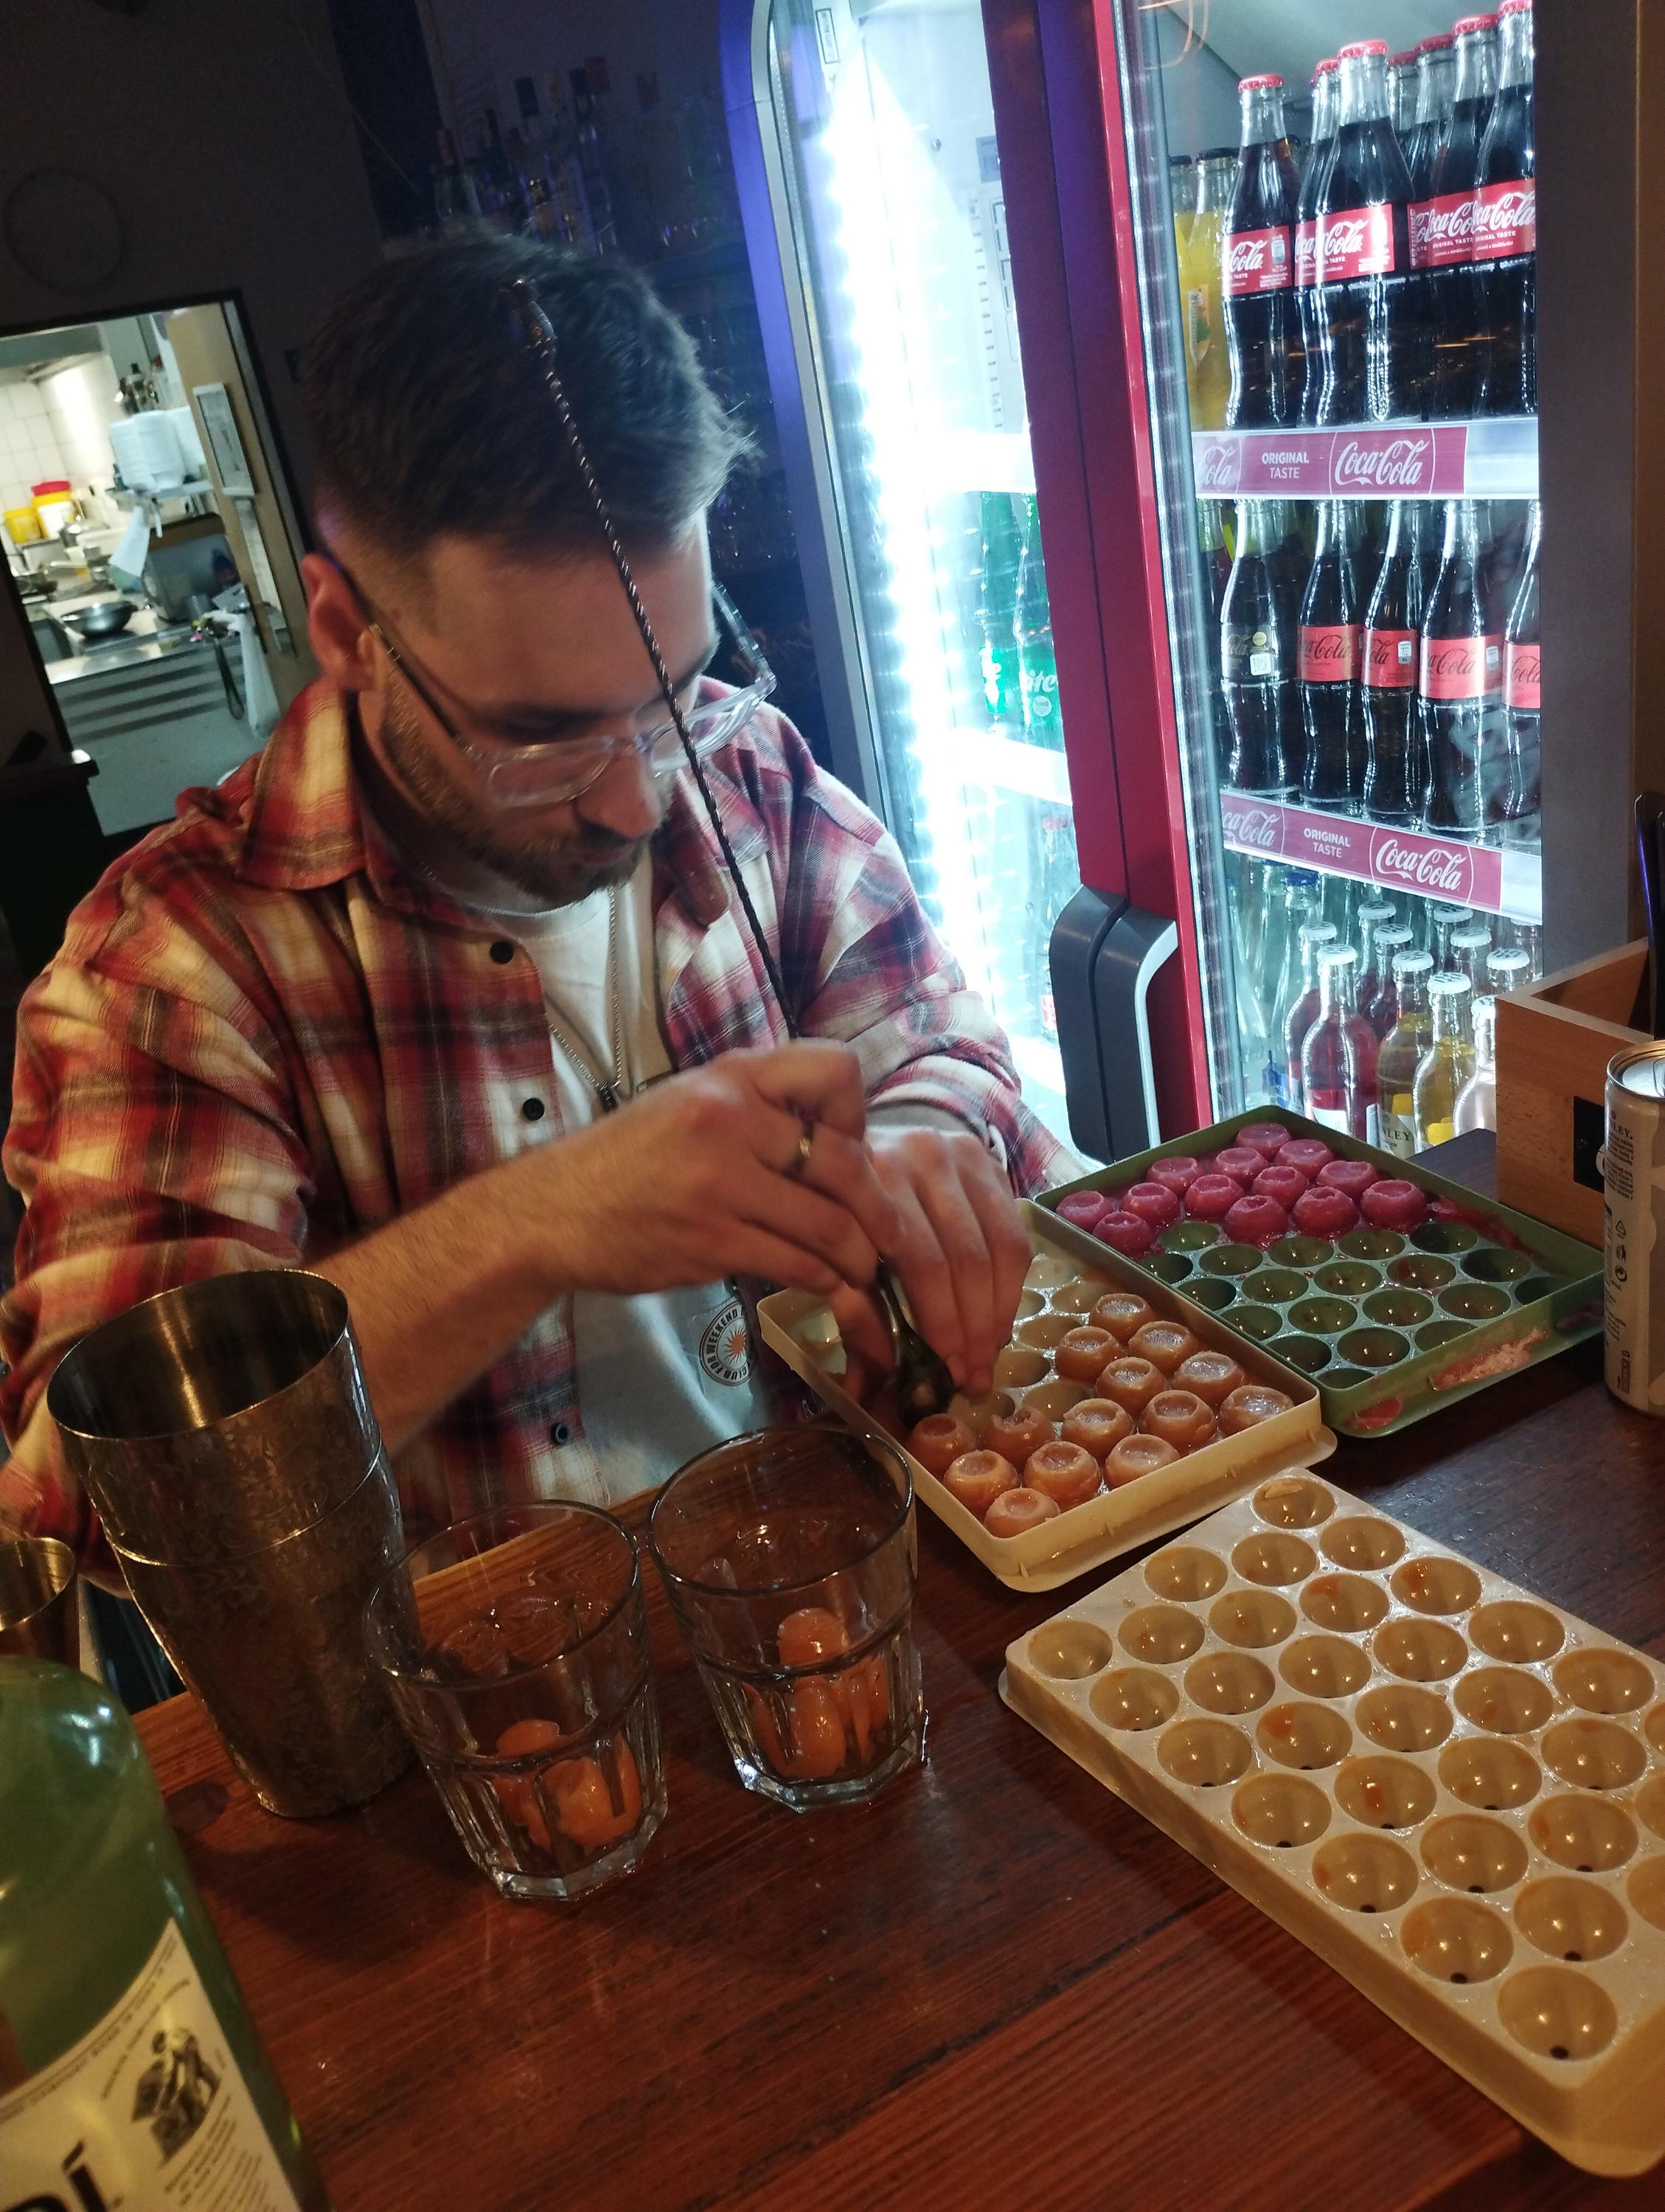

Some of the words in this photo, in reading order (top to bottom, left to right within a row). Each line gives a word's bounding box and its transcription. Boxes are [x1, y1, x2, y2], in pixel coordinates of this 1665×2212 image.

[1262, 451, 1310, 465] ORIGINAL
[1334, 439, 1430, 486] Coca-Cola
[1269, 466, 1300, 479] TASTE
[1304, 827, 1351, 848] ORIGINAL
[1313, 841, 1343, 858] TASTE
[1375, 838, 1466, 891] Coca-Cola
[706, 1308, 738, 1354] WEEKEND
[707, 1355, 724, 1375] FOR
[723, 1366, 747, 1380] CLUB
